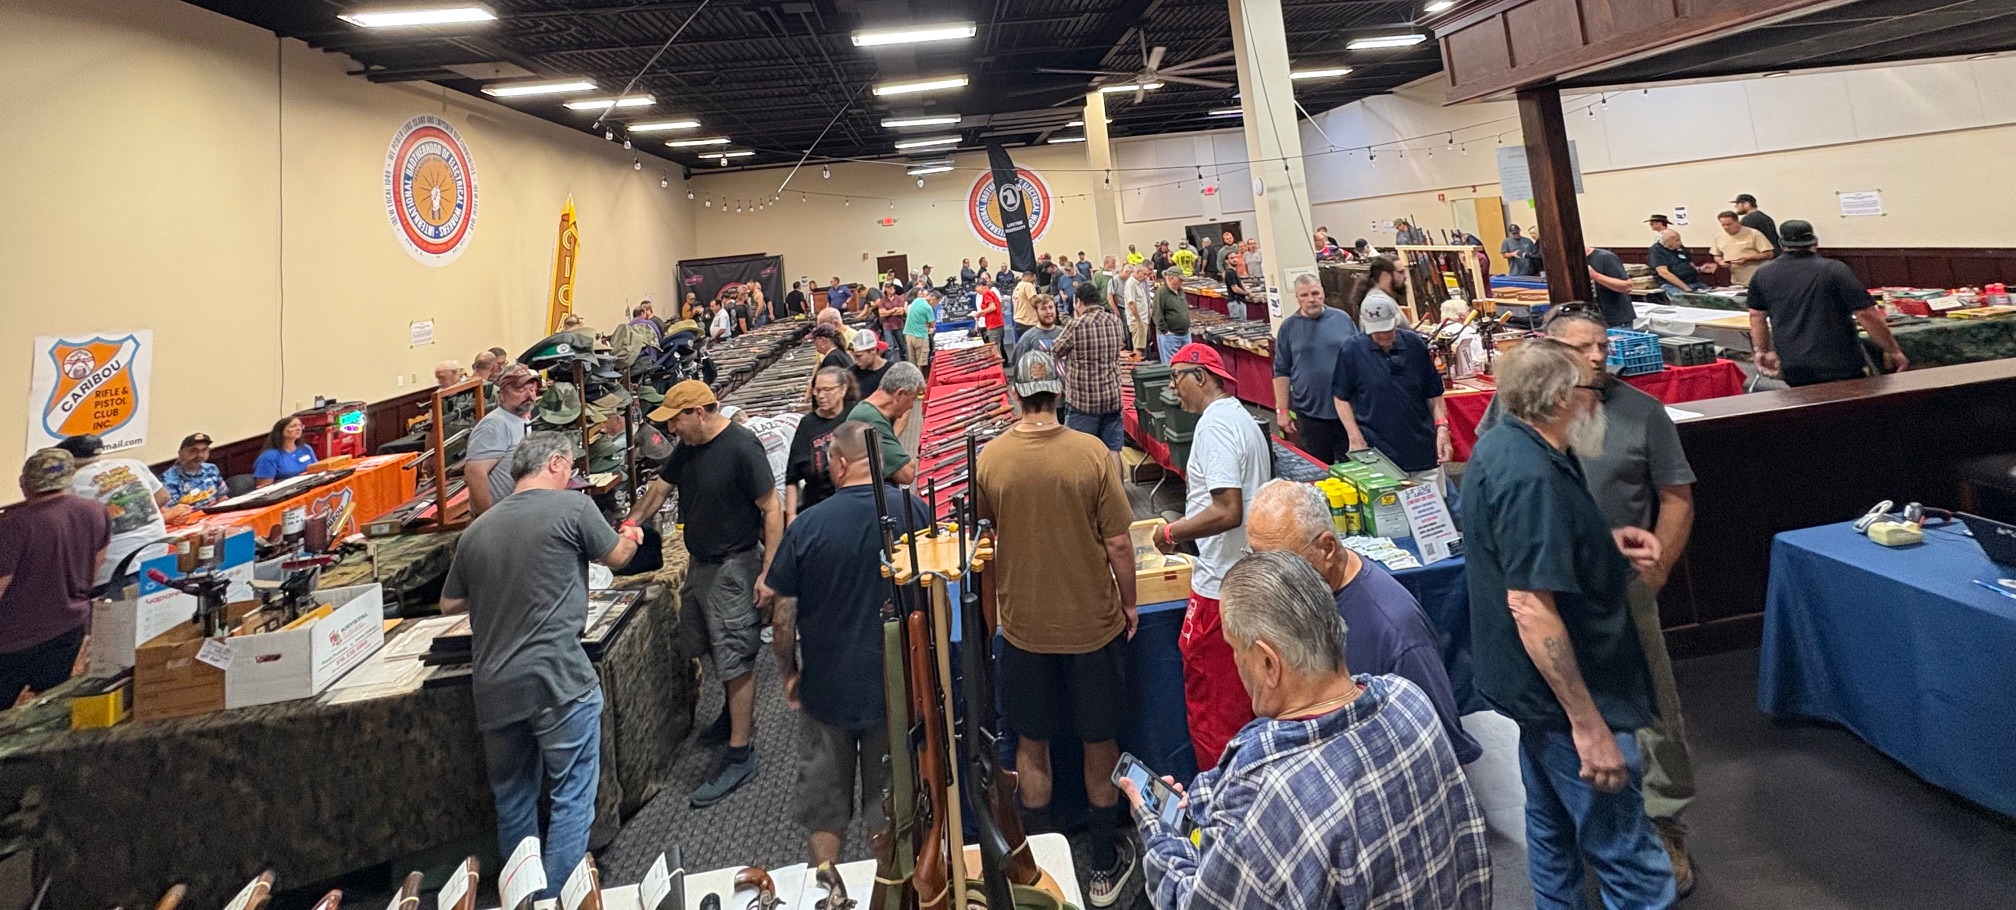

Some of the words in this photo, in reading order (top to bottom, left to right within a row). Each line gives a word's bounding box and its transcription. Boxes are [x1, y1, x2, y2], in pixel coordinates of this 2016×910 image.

[412, 116, 426, 128] ISLAND
[426, 115, 435, 124] AND
[435, 117, 454, 134] EMPOWER
[403, 121, 414, 134] LONG
[391, 130, 404, 151] POWER
[387, 150, 397, 161] WE
[405, 143, 441, 177] BROTHERHOOD
[441, 148, 451, 160] OF
[459, 140, 476, 175] COMMUNITIES
[448, 157, 464, 205] ELECTRICAL
[385, 187, 394, 208] LOCAL
[404, 177, 435, 237] INTERNATIONAL
[388, 209, 399, 227] IBEW
[438, 206, 462, 237] WORKERS
[1190, 351, 1200, 362] 3
[61, 359, 121, 413] CARIBOU
[95, 387, 120, 399] RIFLE
[121, 386, 129, 395] &
[94, 397, 127, 410] PISTOL
[93, 408, 119, 420] CLUB
[92, 420, 114, 431] INC.
